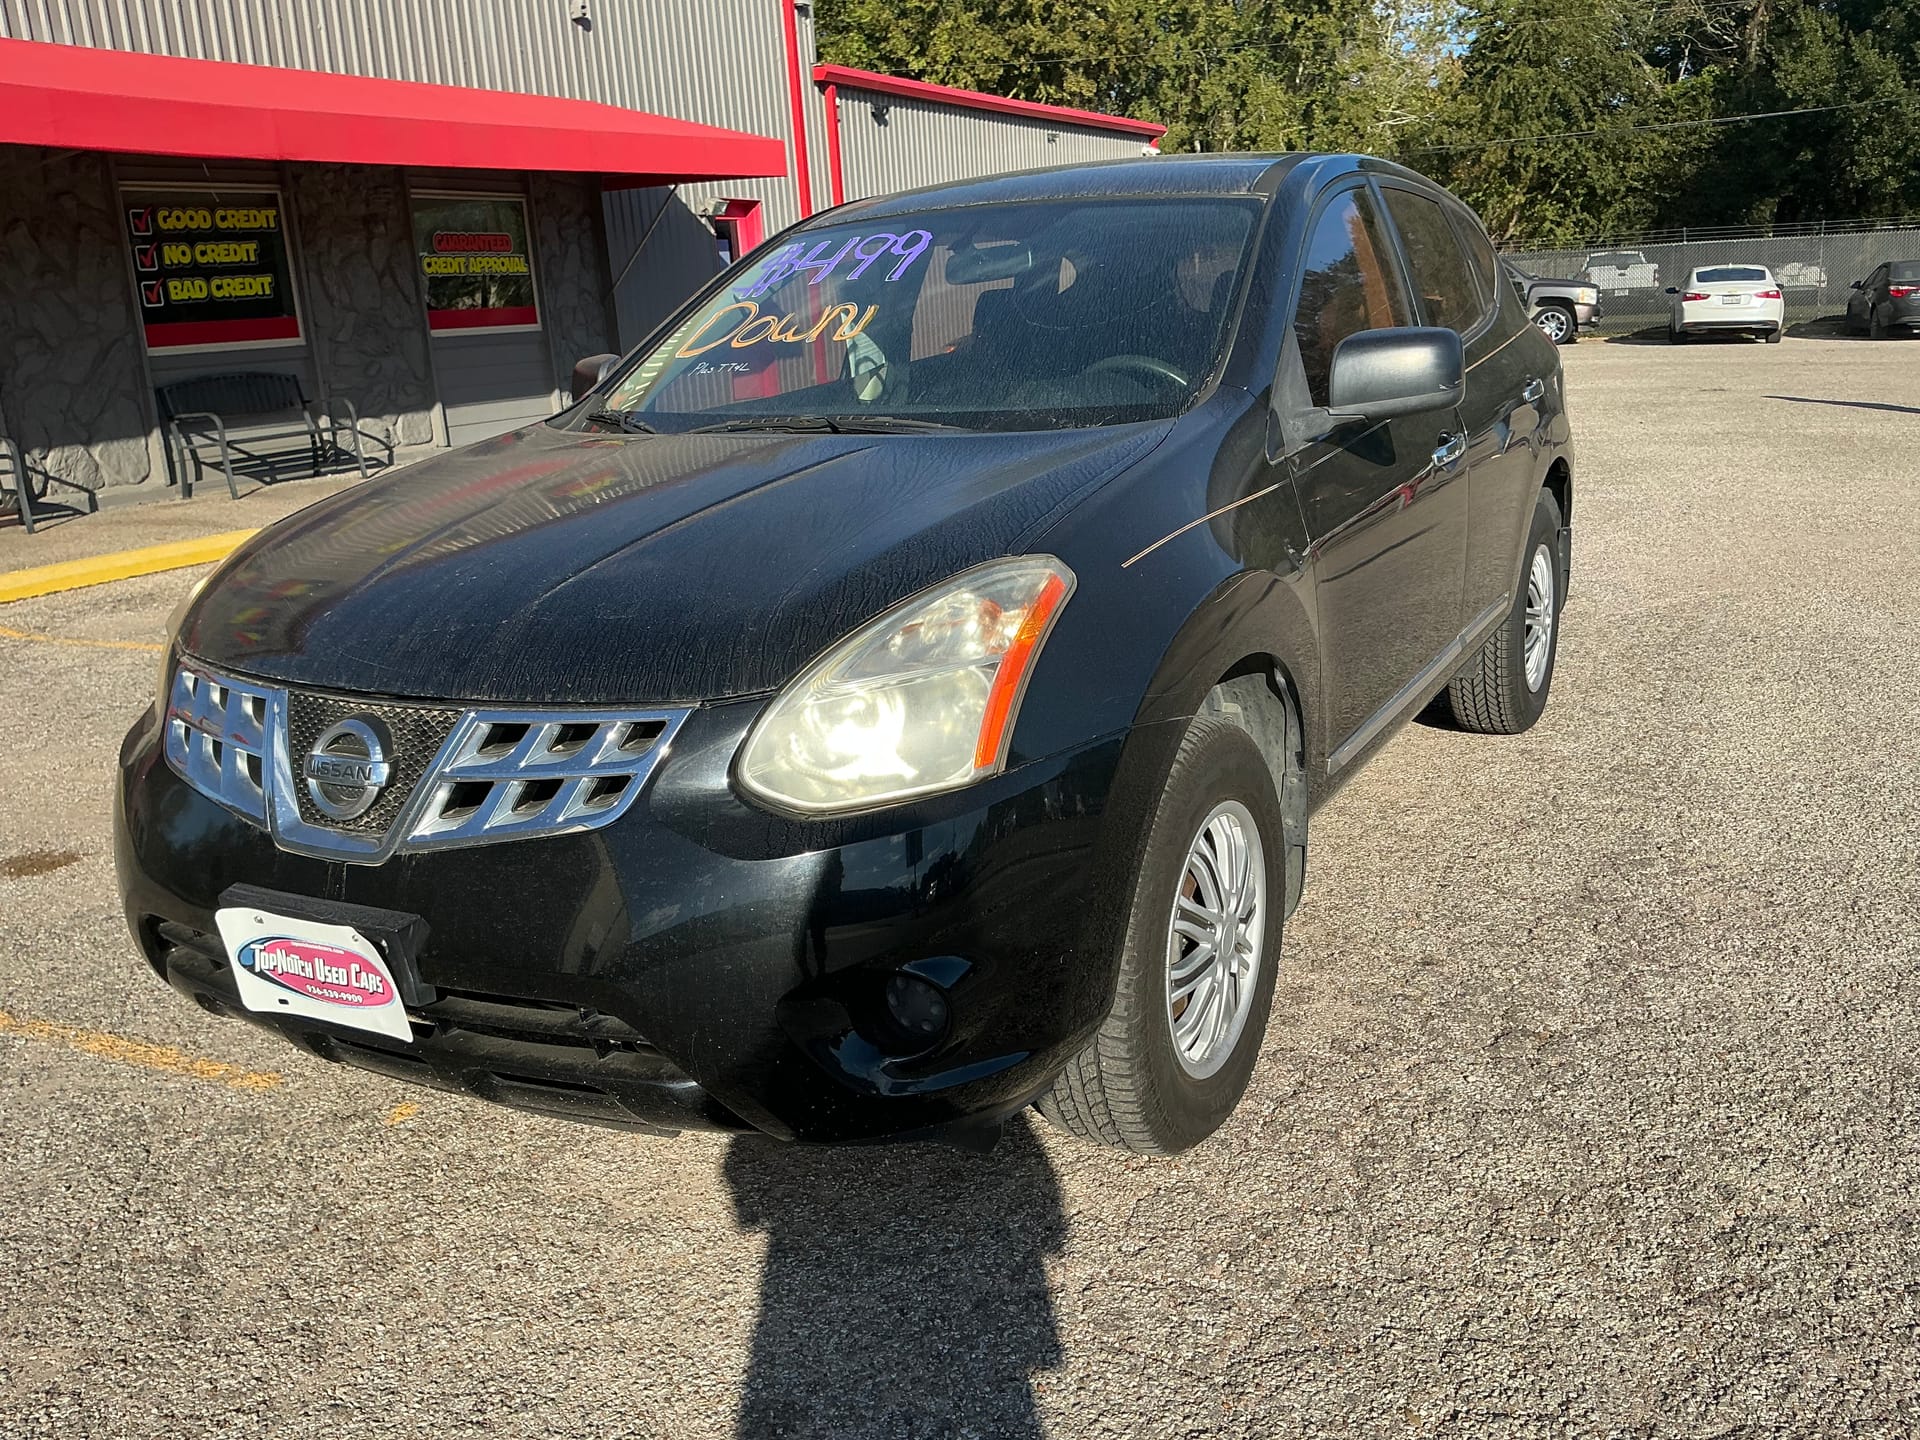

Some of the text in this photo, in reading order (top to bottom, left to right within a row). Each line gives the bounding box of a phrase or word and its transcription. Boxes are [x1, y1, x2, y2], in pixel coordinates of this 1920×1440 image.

[157, 208, 278, 231] GOOD CREDIT
[434, 232, 512, 252] GUARANTEED
[161, 242, 258, 266] NO CREDIT
[423, 256, 529, 275] CREDIT APPROVAL
[732, 230, 933, 299] $499
[168, 276, 273, 301] BAD CREDIT
